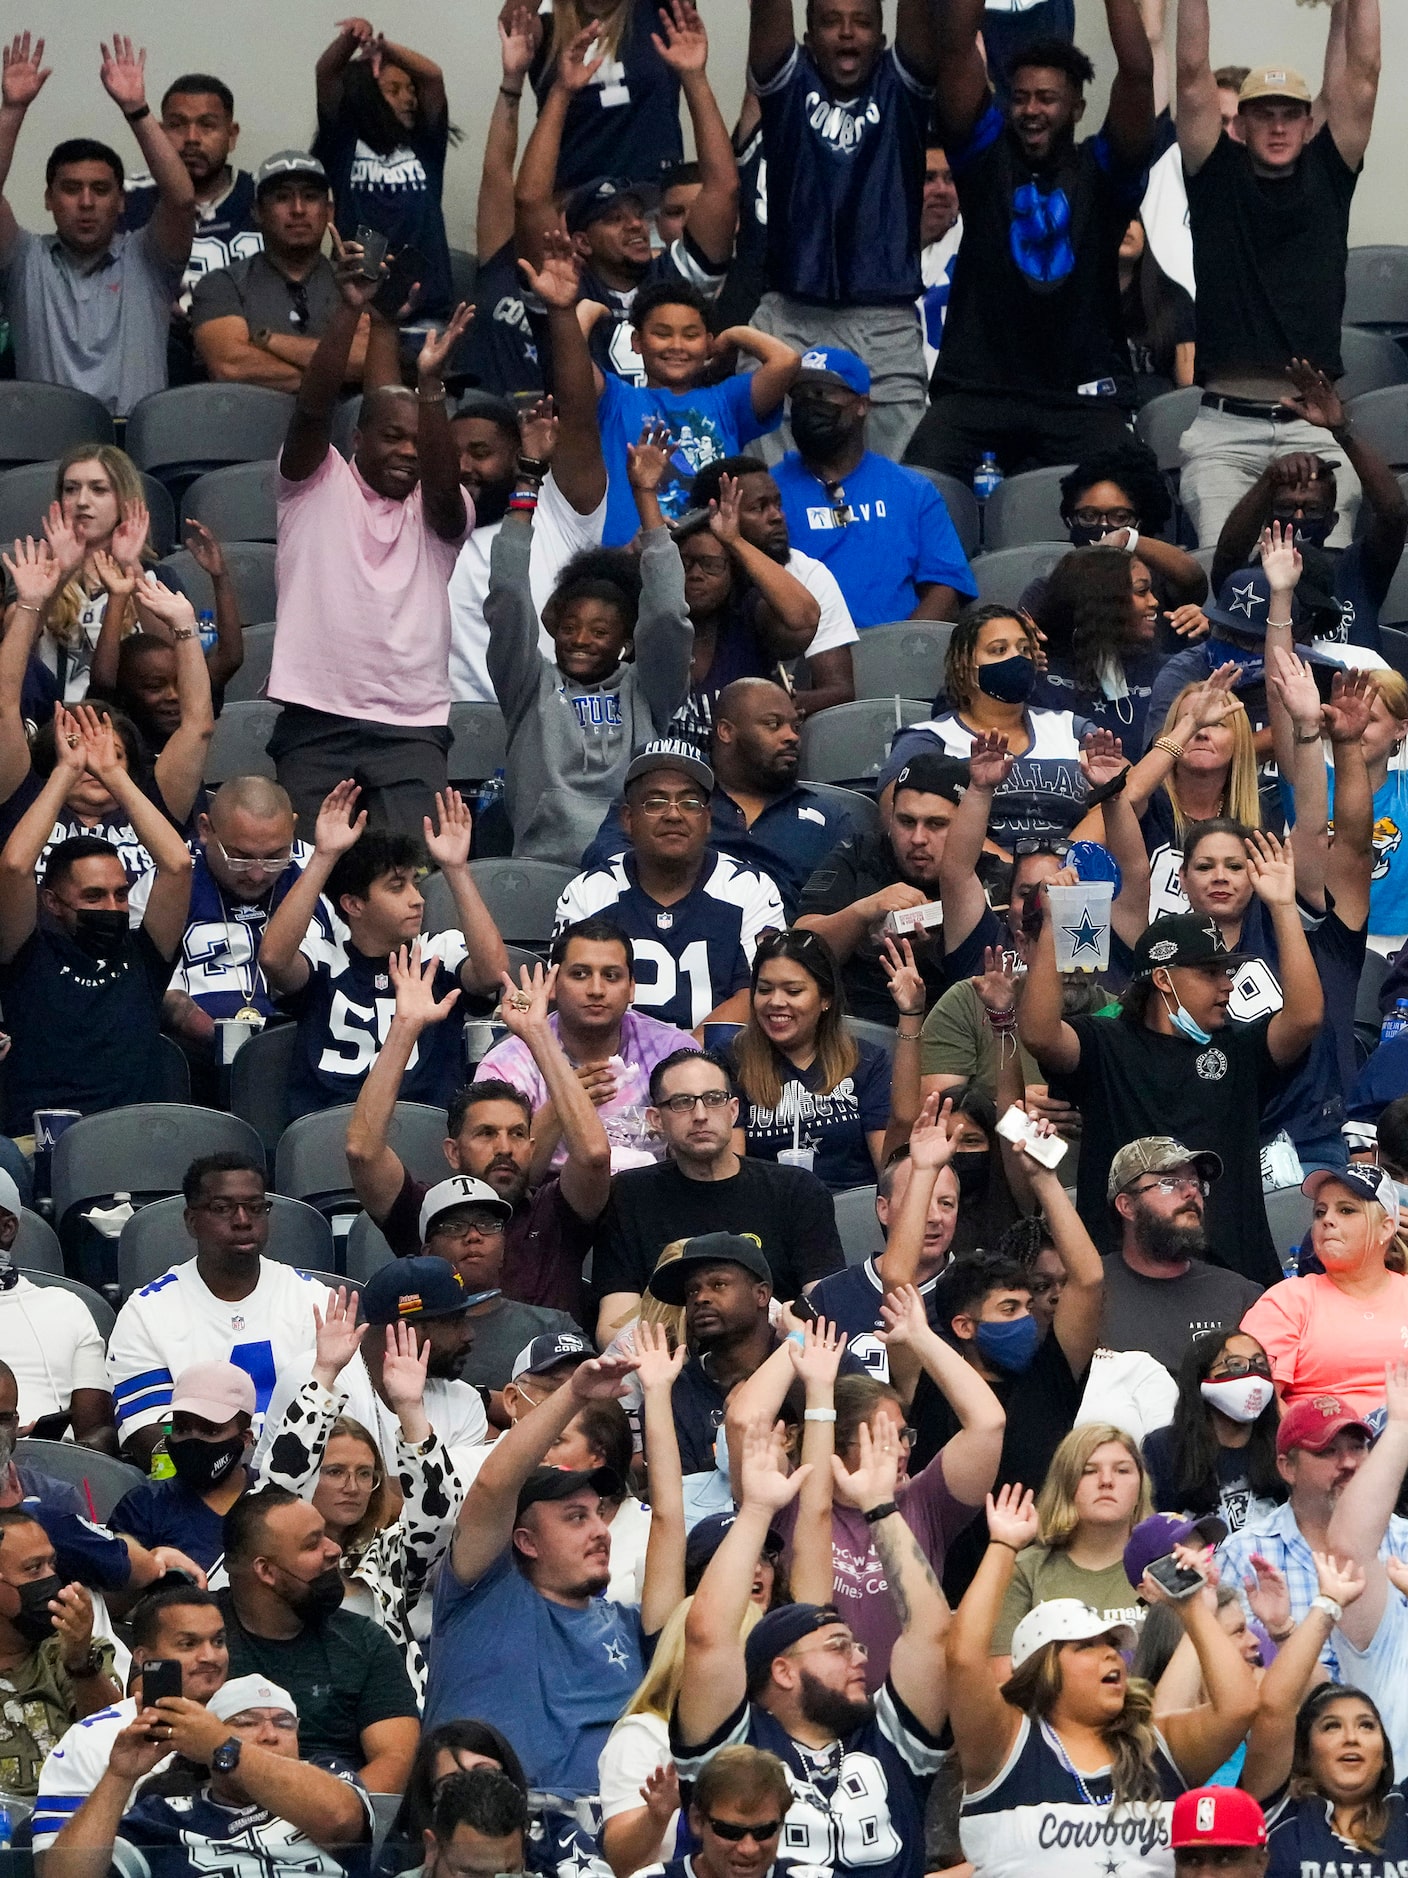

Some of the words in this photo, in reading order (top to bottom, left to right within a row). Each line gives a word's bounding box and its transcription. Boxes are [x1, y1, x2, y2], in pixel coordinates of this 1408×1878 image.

[351, 158, 427, 184] COWBOYS
[632, 938, 713, 1030] 21
[452, 1177, 477, 1196] T
[1189, 1321, 1222, 1329] ARIAT
[213, 1452, 231, 1472] NIKE
[1038, 1811, 1170, 1857] Cowboys
